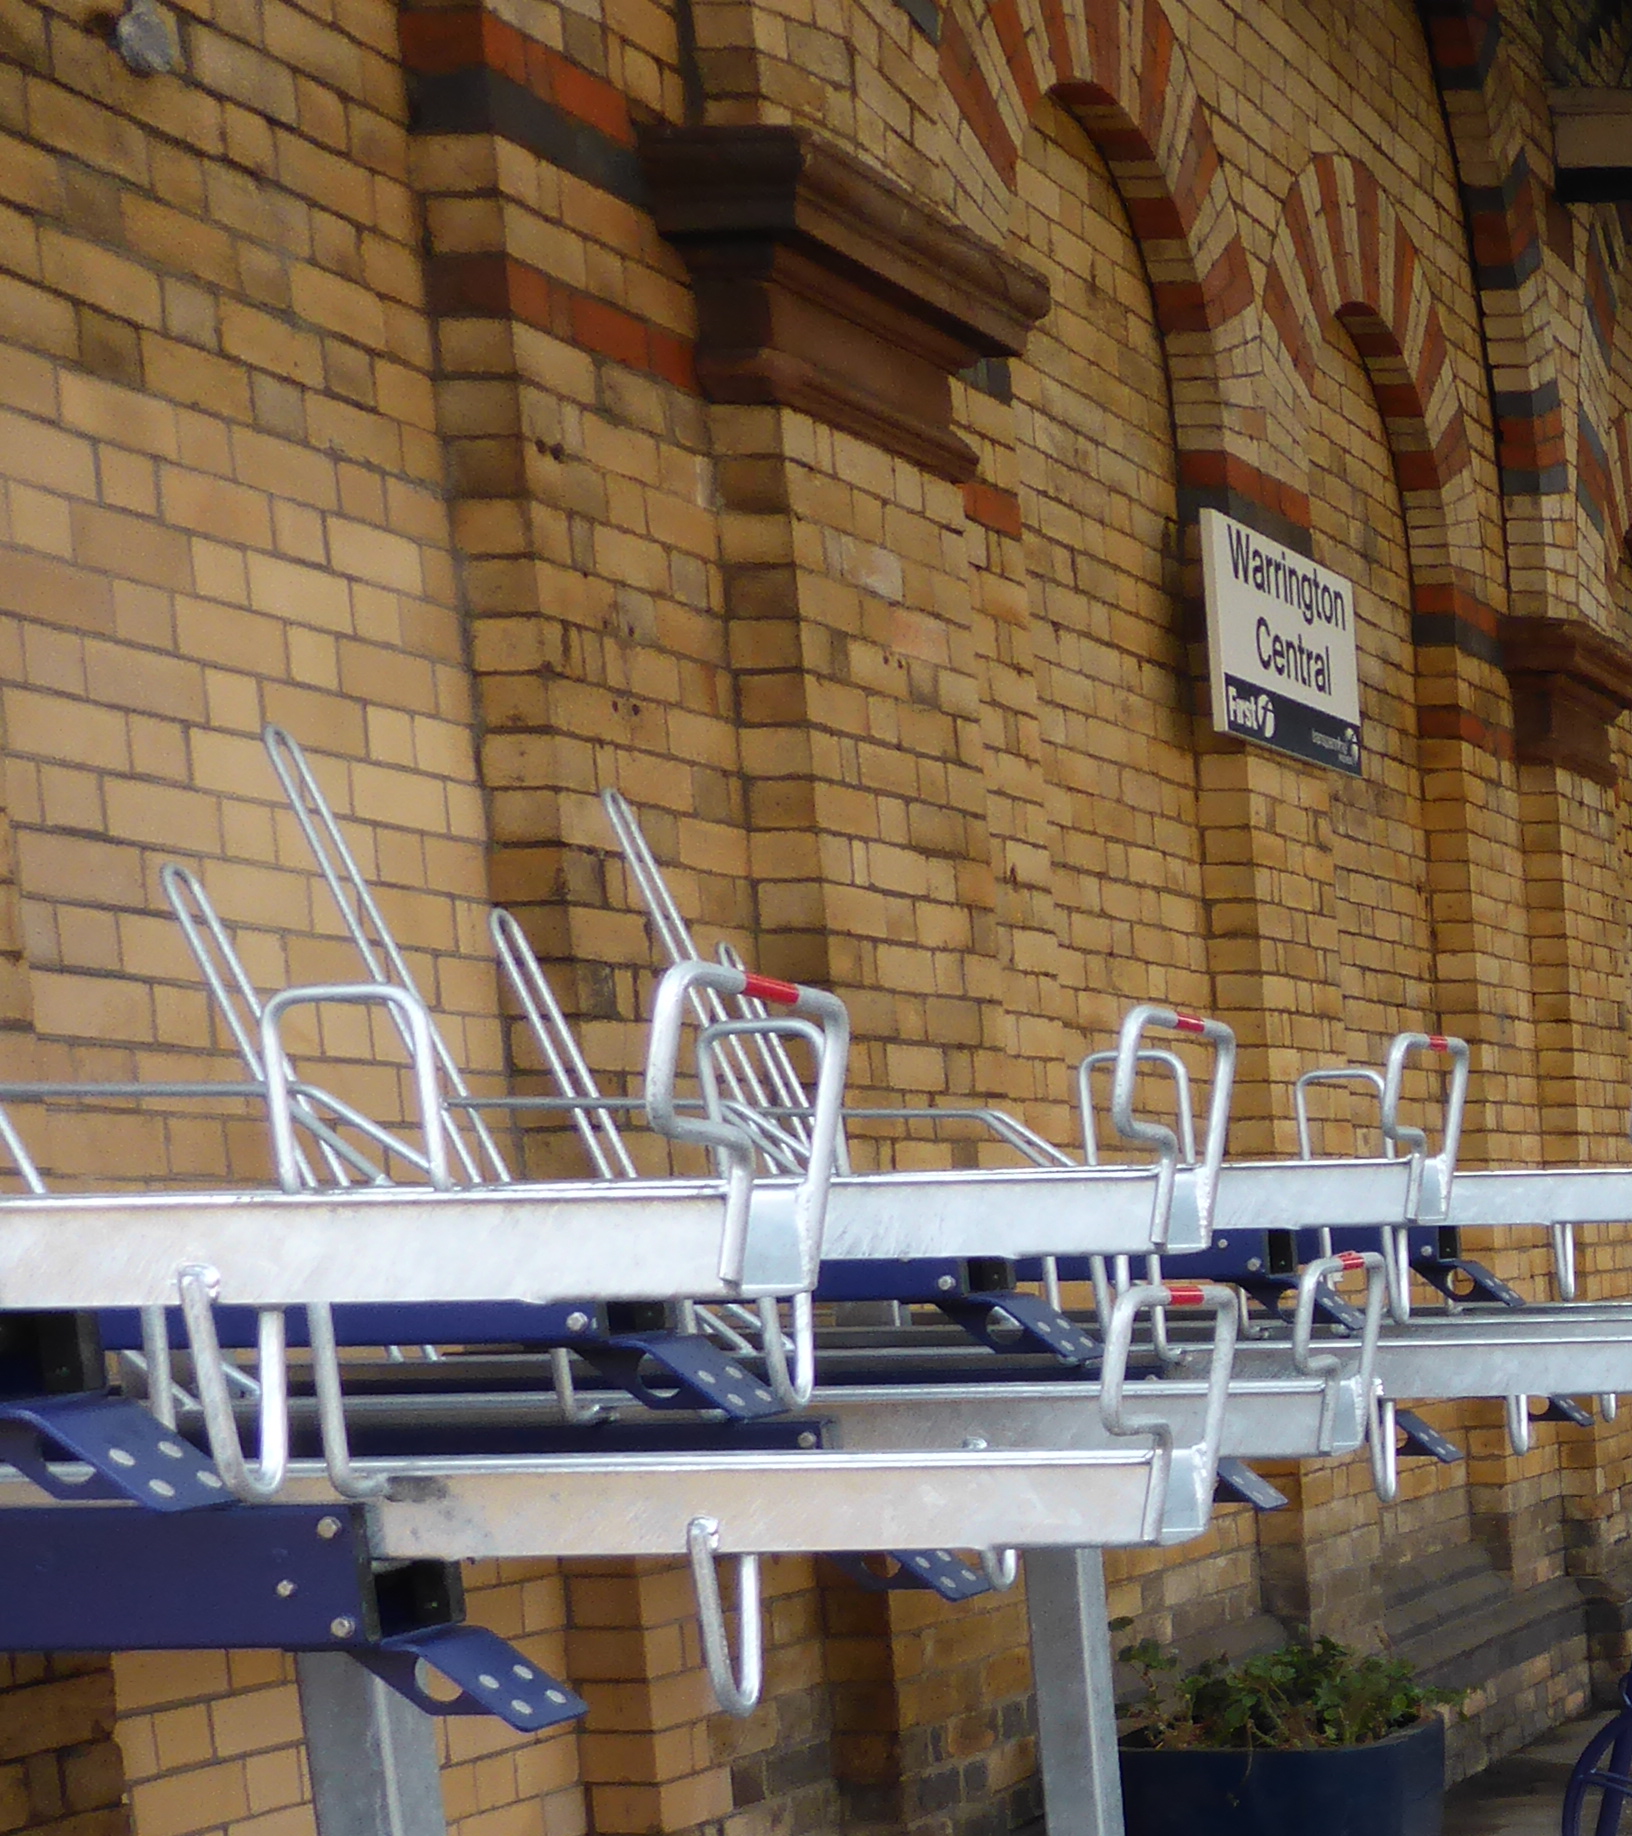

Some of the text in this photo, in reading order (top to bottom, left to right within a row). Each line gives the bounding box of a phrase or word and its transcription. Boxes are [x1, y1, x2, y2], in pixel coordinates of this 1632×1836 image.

[1226, 523, 1346, 631] Warrington
[1256, 616, 1332, 696] Central
[1228, 685, 1258, 730] First
